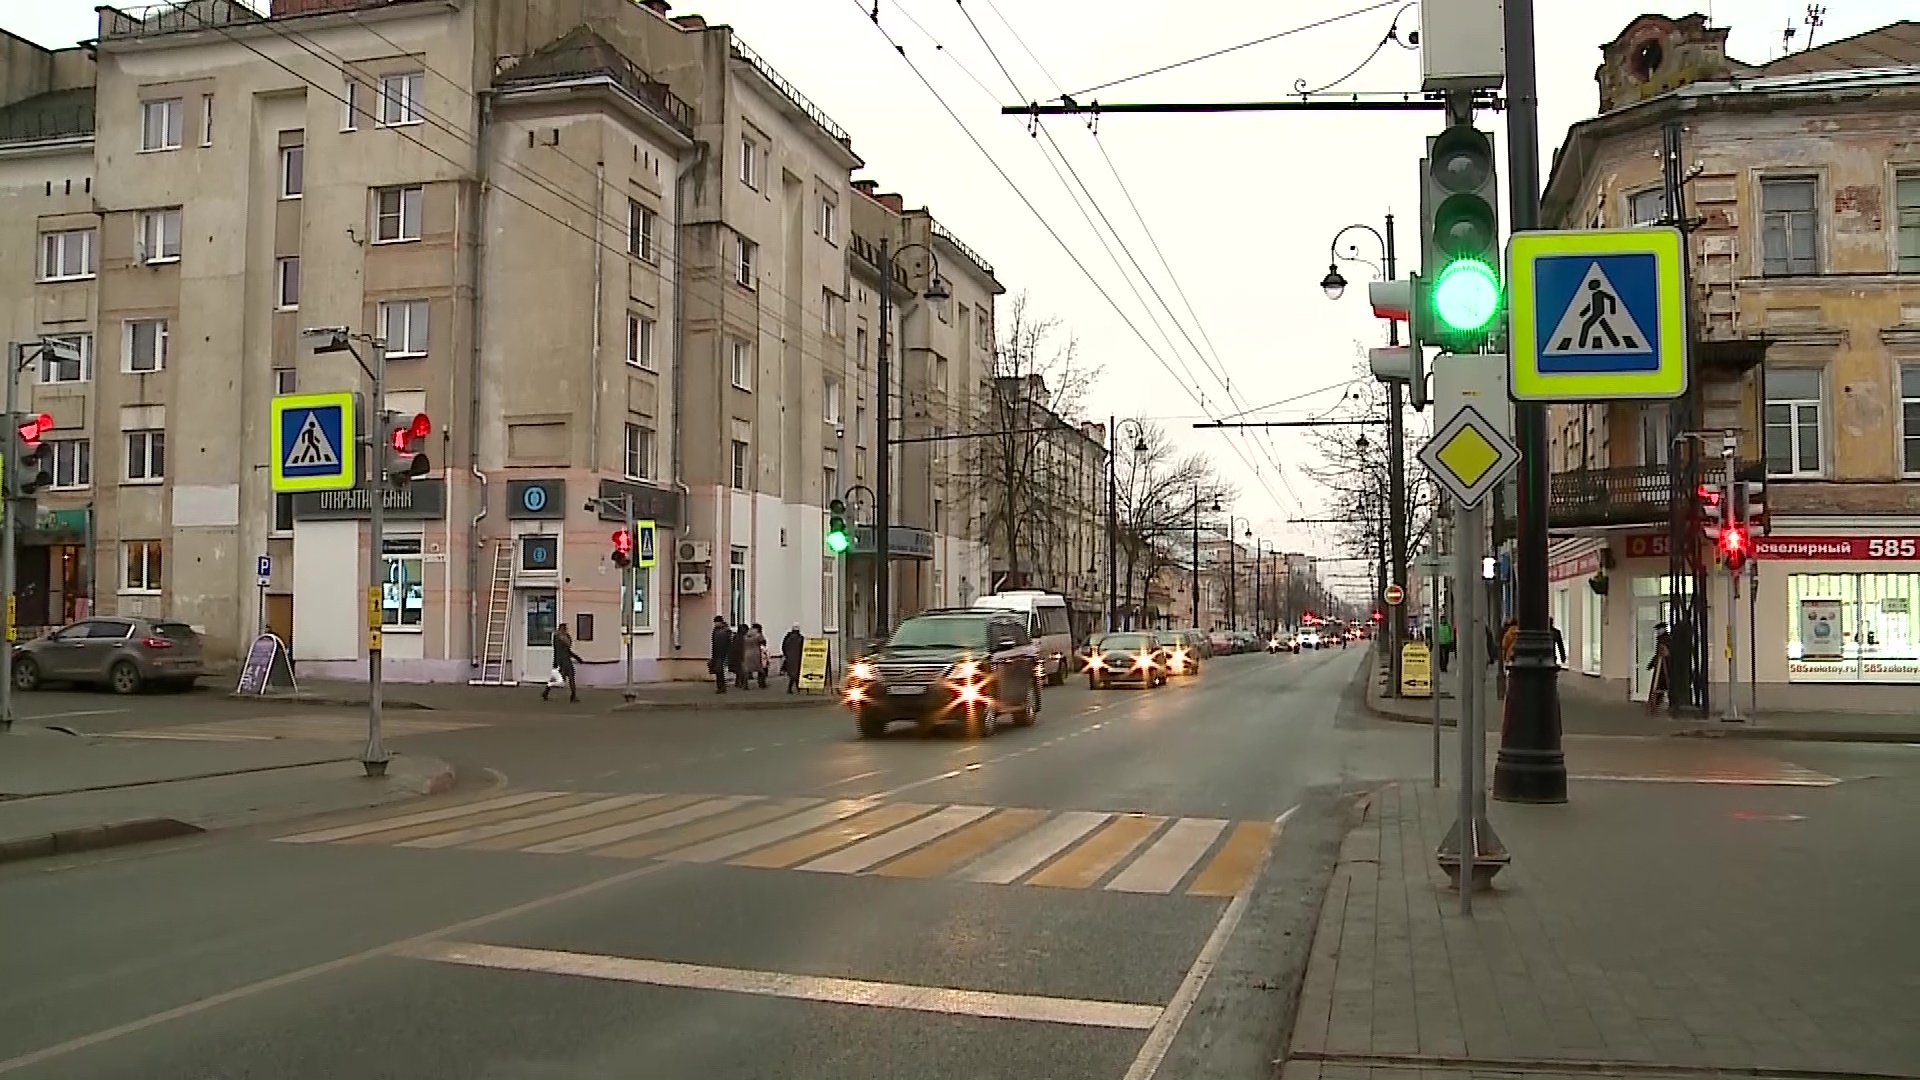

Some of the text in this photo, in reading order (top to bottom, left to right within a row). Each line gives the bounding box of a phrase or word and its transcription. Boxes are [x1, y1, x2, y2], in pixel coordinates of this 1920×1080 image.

[321, 489, 411, 509] ОТКРЫТИ БАНК
[1869, 539, 1915, 557] 585
